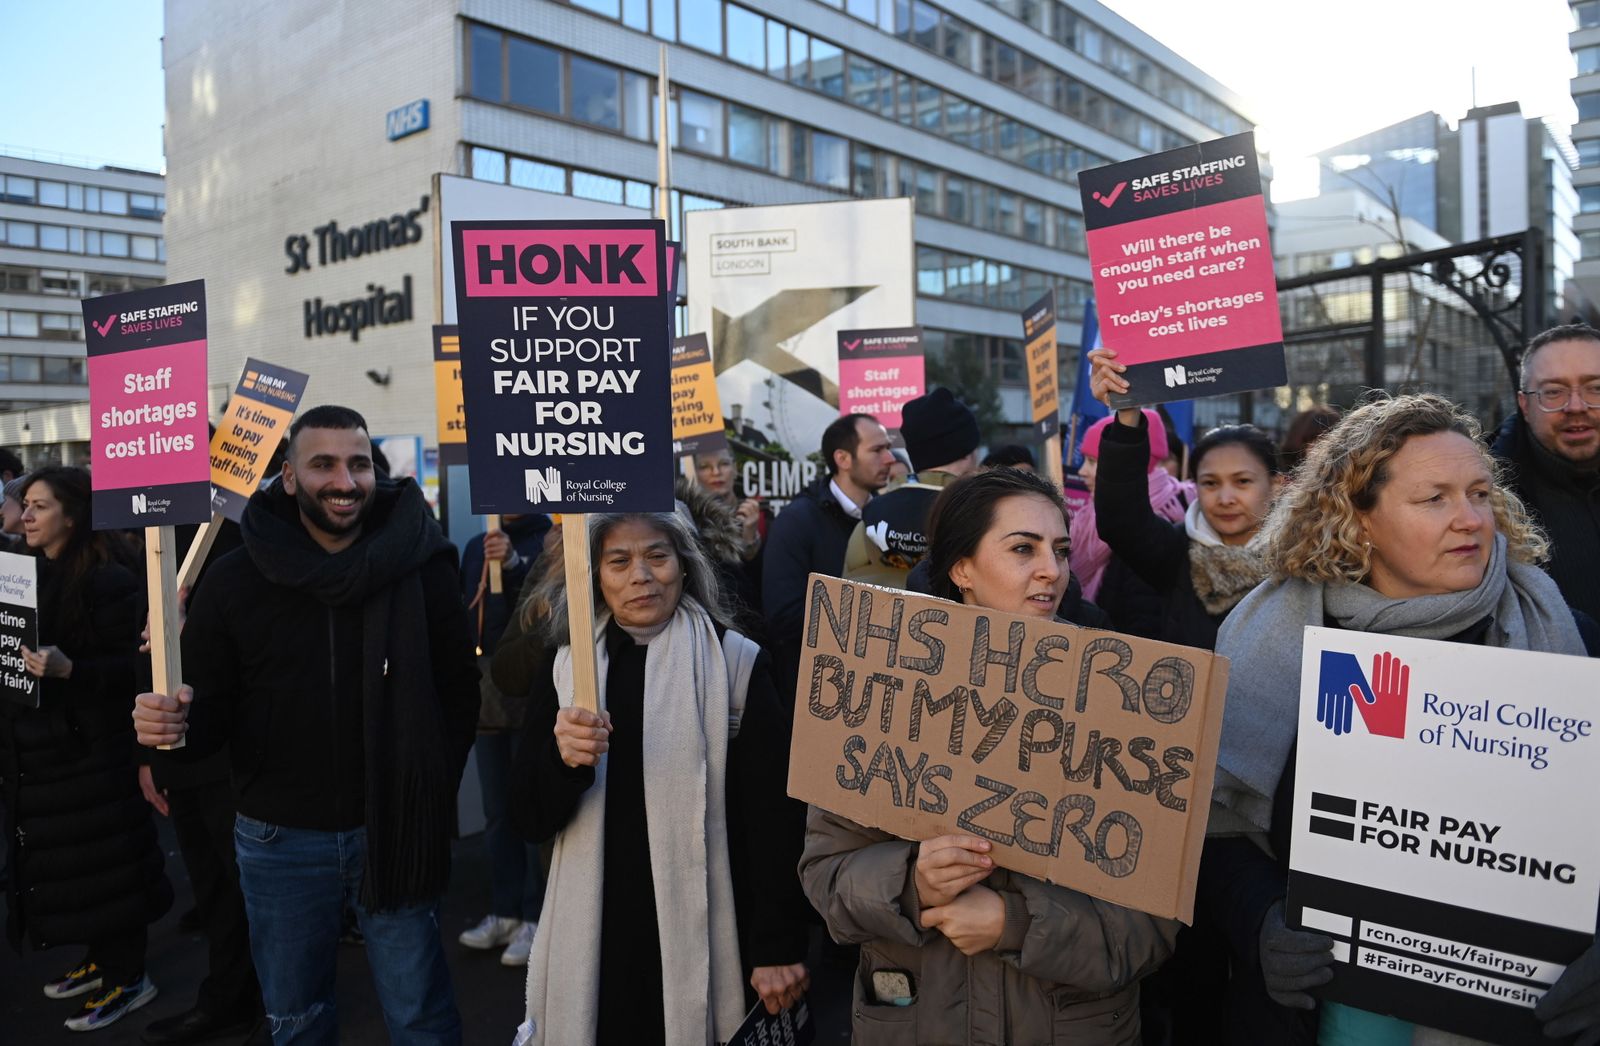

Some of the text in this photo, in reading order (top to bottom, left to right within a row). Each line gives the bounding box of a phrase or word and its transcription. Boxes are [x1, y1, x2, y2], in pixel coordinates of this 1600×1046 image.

[388, 101, 424, 138] NHS
[1132, 155, 1246, 190] SAFE STAFFING
[1134, 173, 1223, 202] SAVES LIVES
[284, 194, 430, 274] St Thomas'
[716, 236, 789, 249] SOUTH BANK
[1121, 225, 1232, 256] Will there be
[476, 243, 646, 285] HONK
[716, 259, 764, 270] LONDON
[1100, 238, 1261, 277] enough staff when
[1117, 256, 1246, 295] you need care?
[120, 301, 198, 323] SAFE STAFFING
[304, 273, 413, 342] Hospital
[1176, 291, 1264, 316] shortages
[121, 316, 183, 335] SAVES LIVES
[513, 305, 615, 331] IF YOU
[1148, 315, 1228, 337] cost lives
[490, 337, 641, 363] SUPPORT
[863, 335, 919, 345] SAFE STAFFING
[124, 367, 172, 394] Staff
[258, 374, 287, 389] FAIR PAY
[493, 369, 641, 394] FAIR PAY
[864, 368, 900, 382] Staff
[1187, 367, 1223, 377] Royal College
[1195, 375, 1217, 383] Nursing
[255, 384, 296, 403] FOR NURSING
[672, 388, 696, 401] pay
[847, 385, 918, 399] shortages
[101, 401, 197, 428] shortages
[252, 410, 277, 429] time
[535, 401, 603, 425] FOR
[850, 400, 903, 414] cost liv
[680, 412, 714, 428] fairly
[105, 431, 195, 459] cost lives
[232, 424, 264, 446] to pay
[495, 431, 645, 456] NURSING
[220, 441, 258, 465] nursing
[229, 459, 257, 485] fairly
[566, 479, 627, 492] Royal College
[566, 492, 614, 504] of Nursing
[888, 530, 912, 541] Royal
[1, 634, 21, 650] pay
[806, 579, 1195, 724] NHS HERO
[4, 672, 34, 694] fairly
[1423, 693, 1592, 743] Royal College
[808, 654, 1194, 812] BUT MY PURSE
[1419, 724, 1550, 770] of Nursing
[836, 734, 1143, 878] SAYS ZERO
[1361, 801, 1502, 844] FAIR PAY
[1360, 827, 1577, 885] FOR NURSING
[1366, 925, 1539, 978] rcn.org.uk/fairpay
